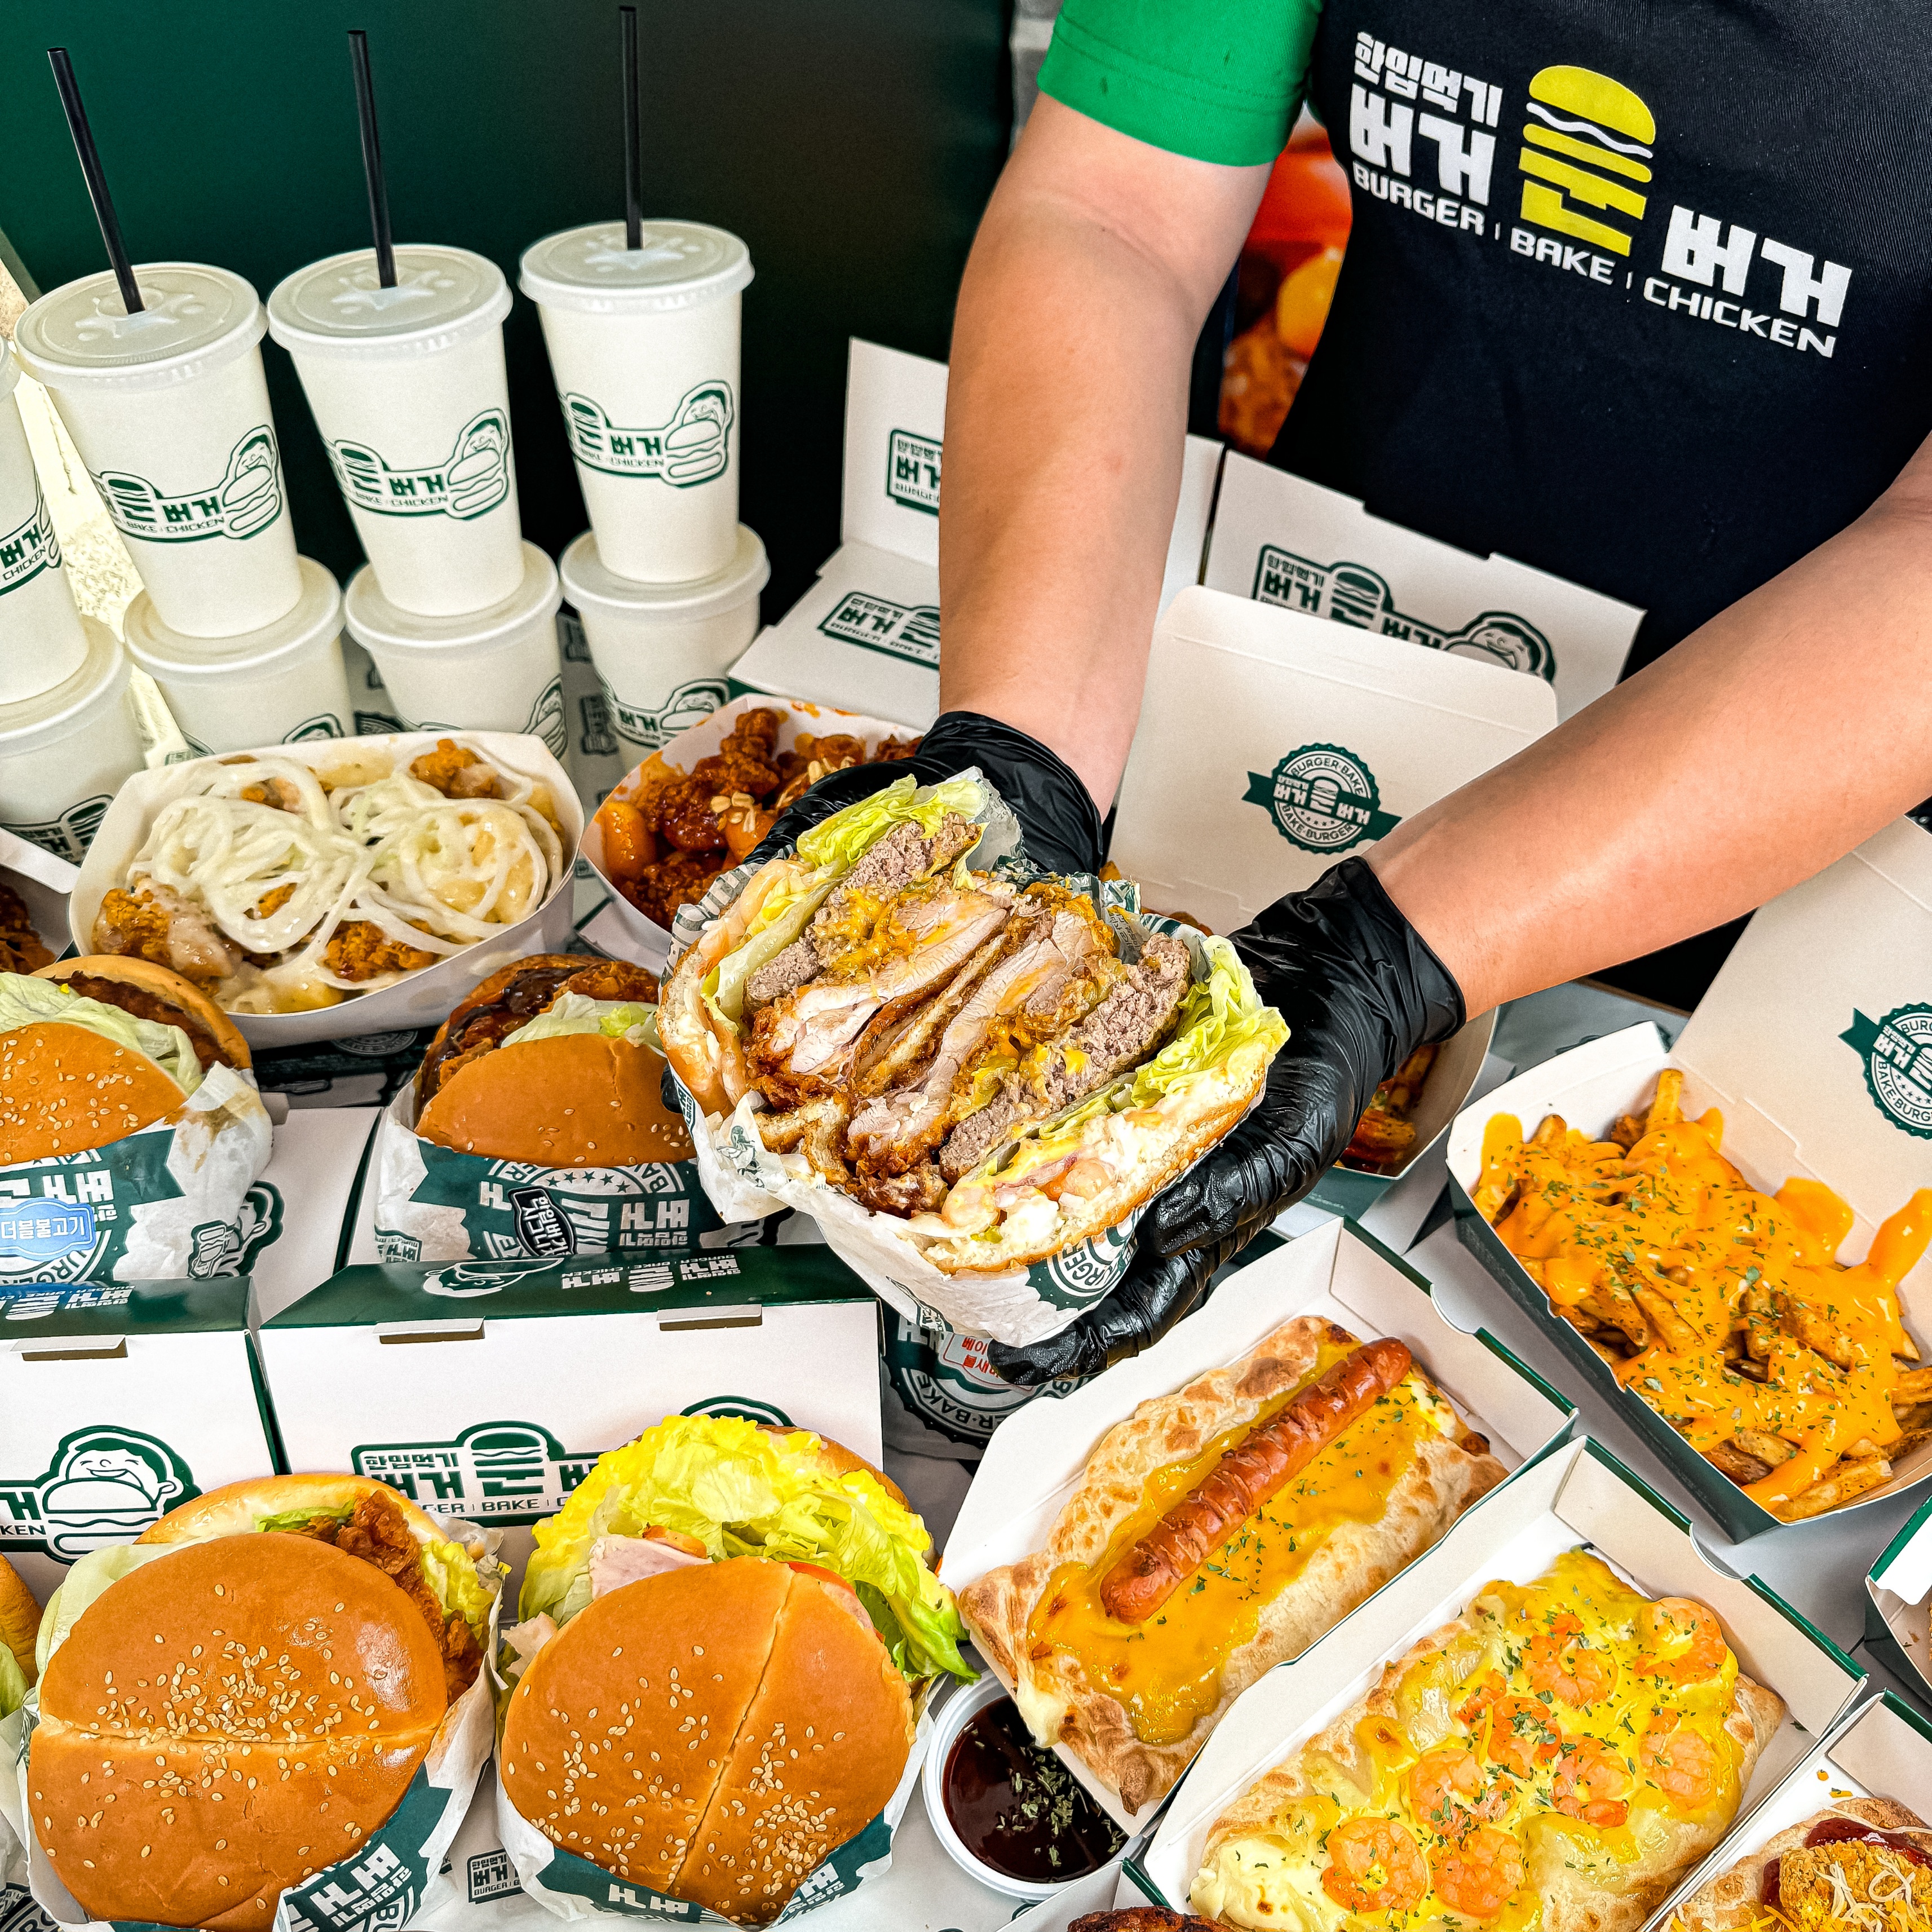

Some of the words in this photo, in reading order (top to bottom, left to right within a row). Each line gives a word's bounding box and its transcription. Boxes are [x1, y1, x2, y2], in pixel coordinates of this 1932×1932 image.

[1355, 32, 1504, 128] 한입먹기
[1350, 83, 1497, 205] 버거
[1661, 205, 1853, 328] 버거
[1353, 161, 1484, 236] BURGER
[1511, 228, 1616, 286] BAKE
[1644, 277, 1836, 359] CHICKEN
[1895, 1099, 1932, 1121] BURG
[1, 1215, 85, 1240] 더블불고기
[916, 1374, 976, 1422] BAKE
[365, 1452, 459, 1470] 한입먹기
[481, 1498, 541, 1512] BAKE
[474, 1882, 508, 1896] BURGER
